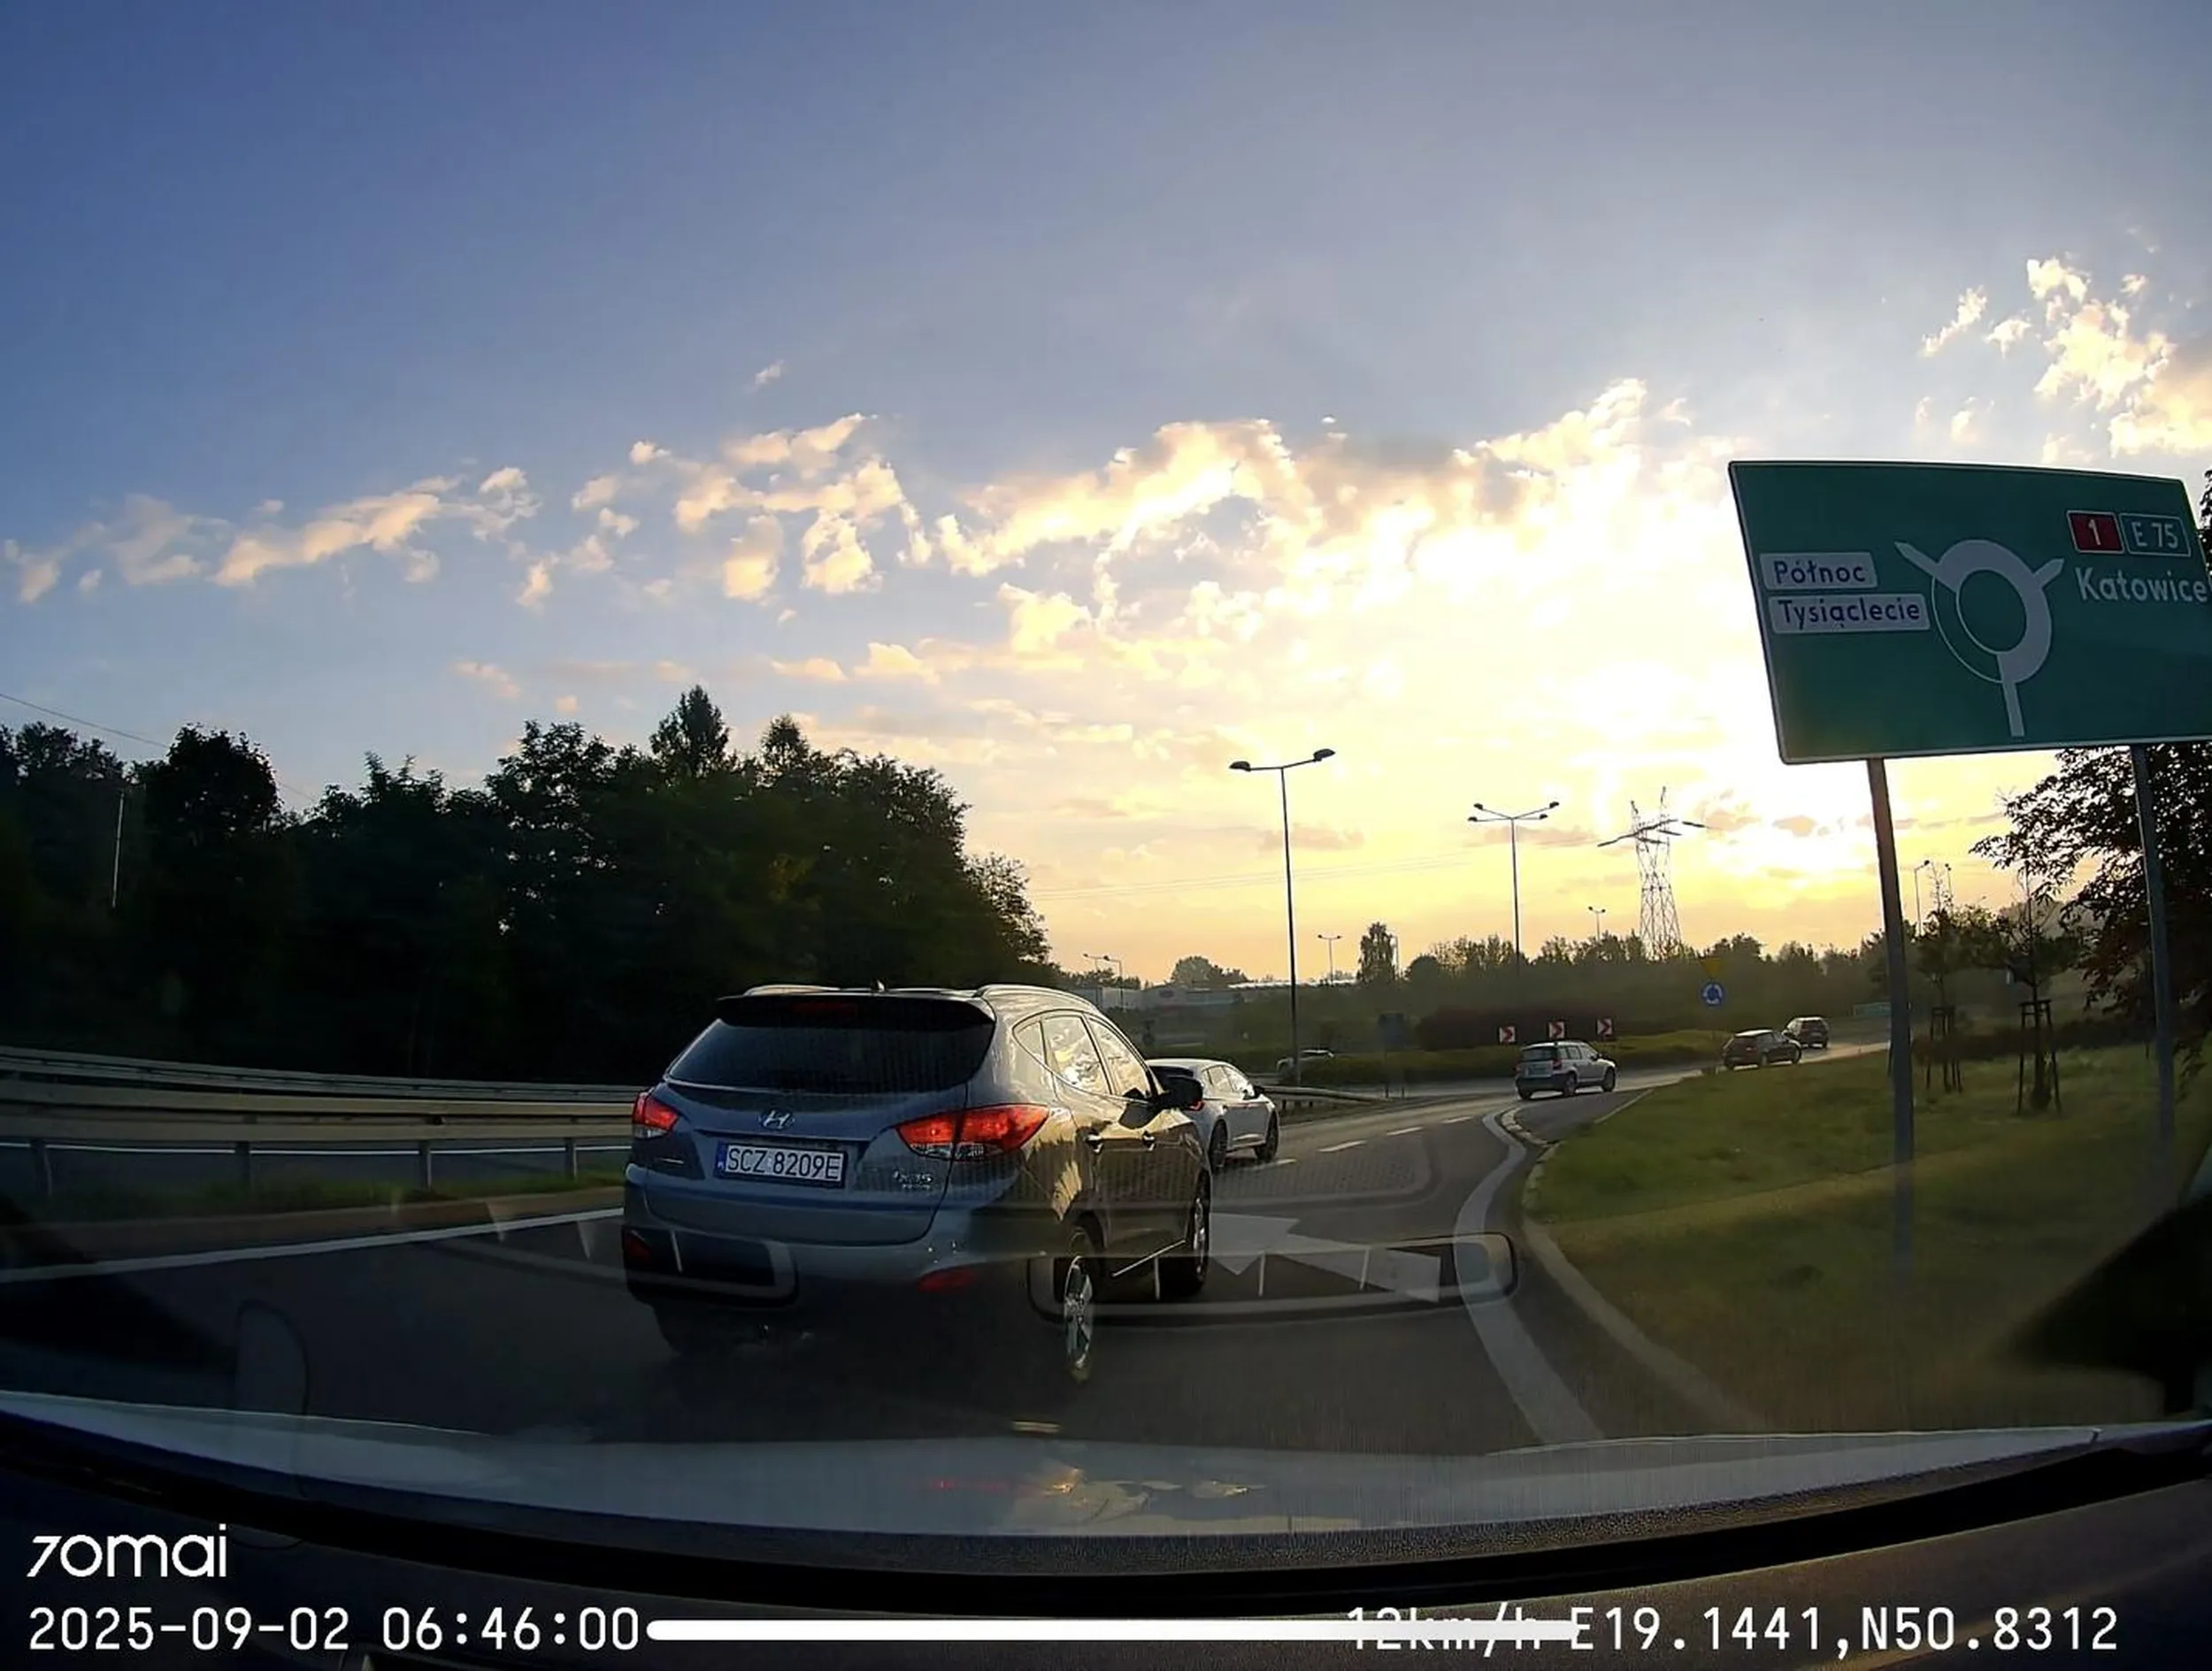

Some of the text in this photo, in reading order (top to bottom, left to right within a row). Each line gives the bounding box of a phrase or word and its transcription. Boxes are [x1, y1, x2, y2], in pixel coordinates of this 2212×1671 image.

[2087, 518, 2101, 546] 1
[2131, 521, 2178, 549] E 75
[1773, 559, 1867, 585] Północ
[2074, 567, 2208, 603] Katowice
[1778, 596, 1920, 631] Tysiąclecie
[727, 1147, 841, 1180] SCZ 8209E
